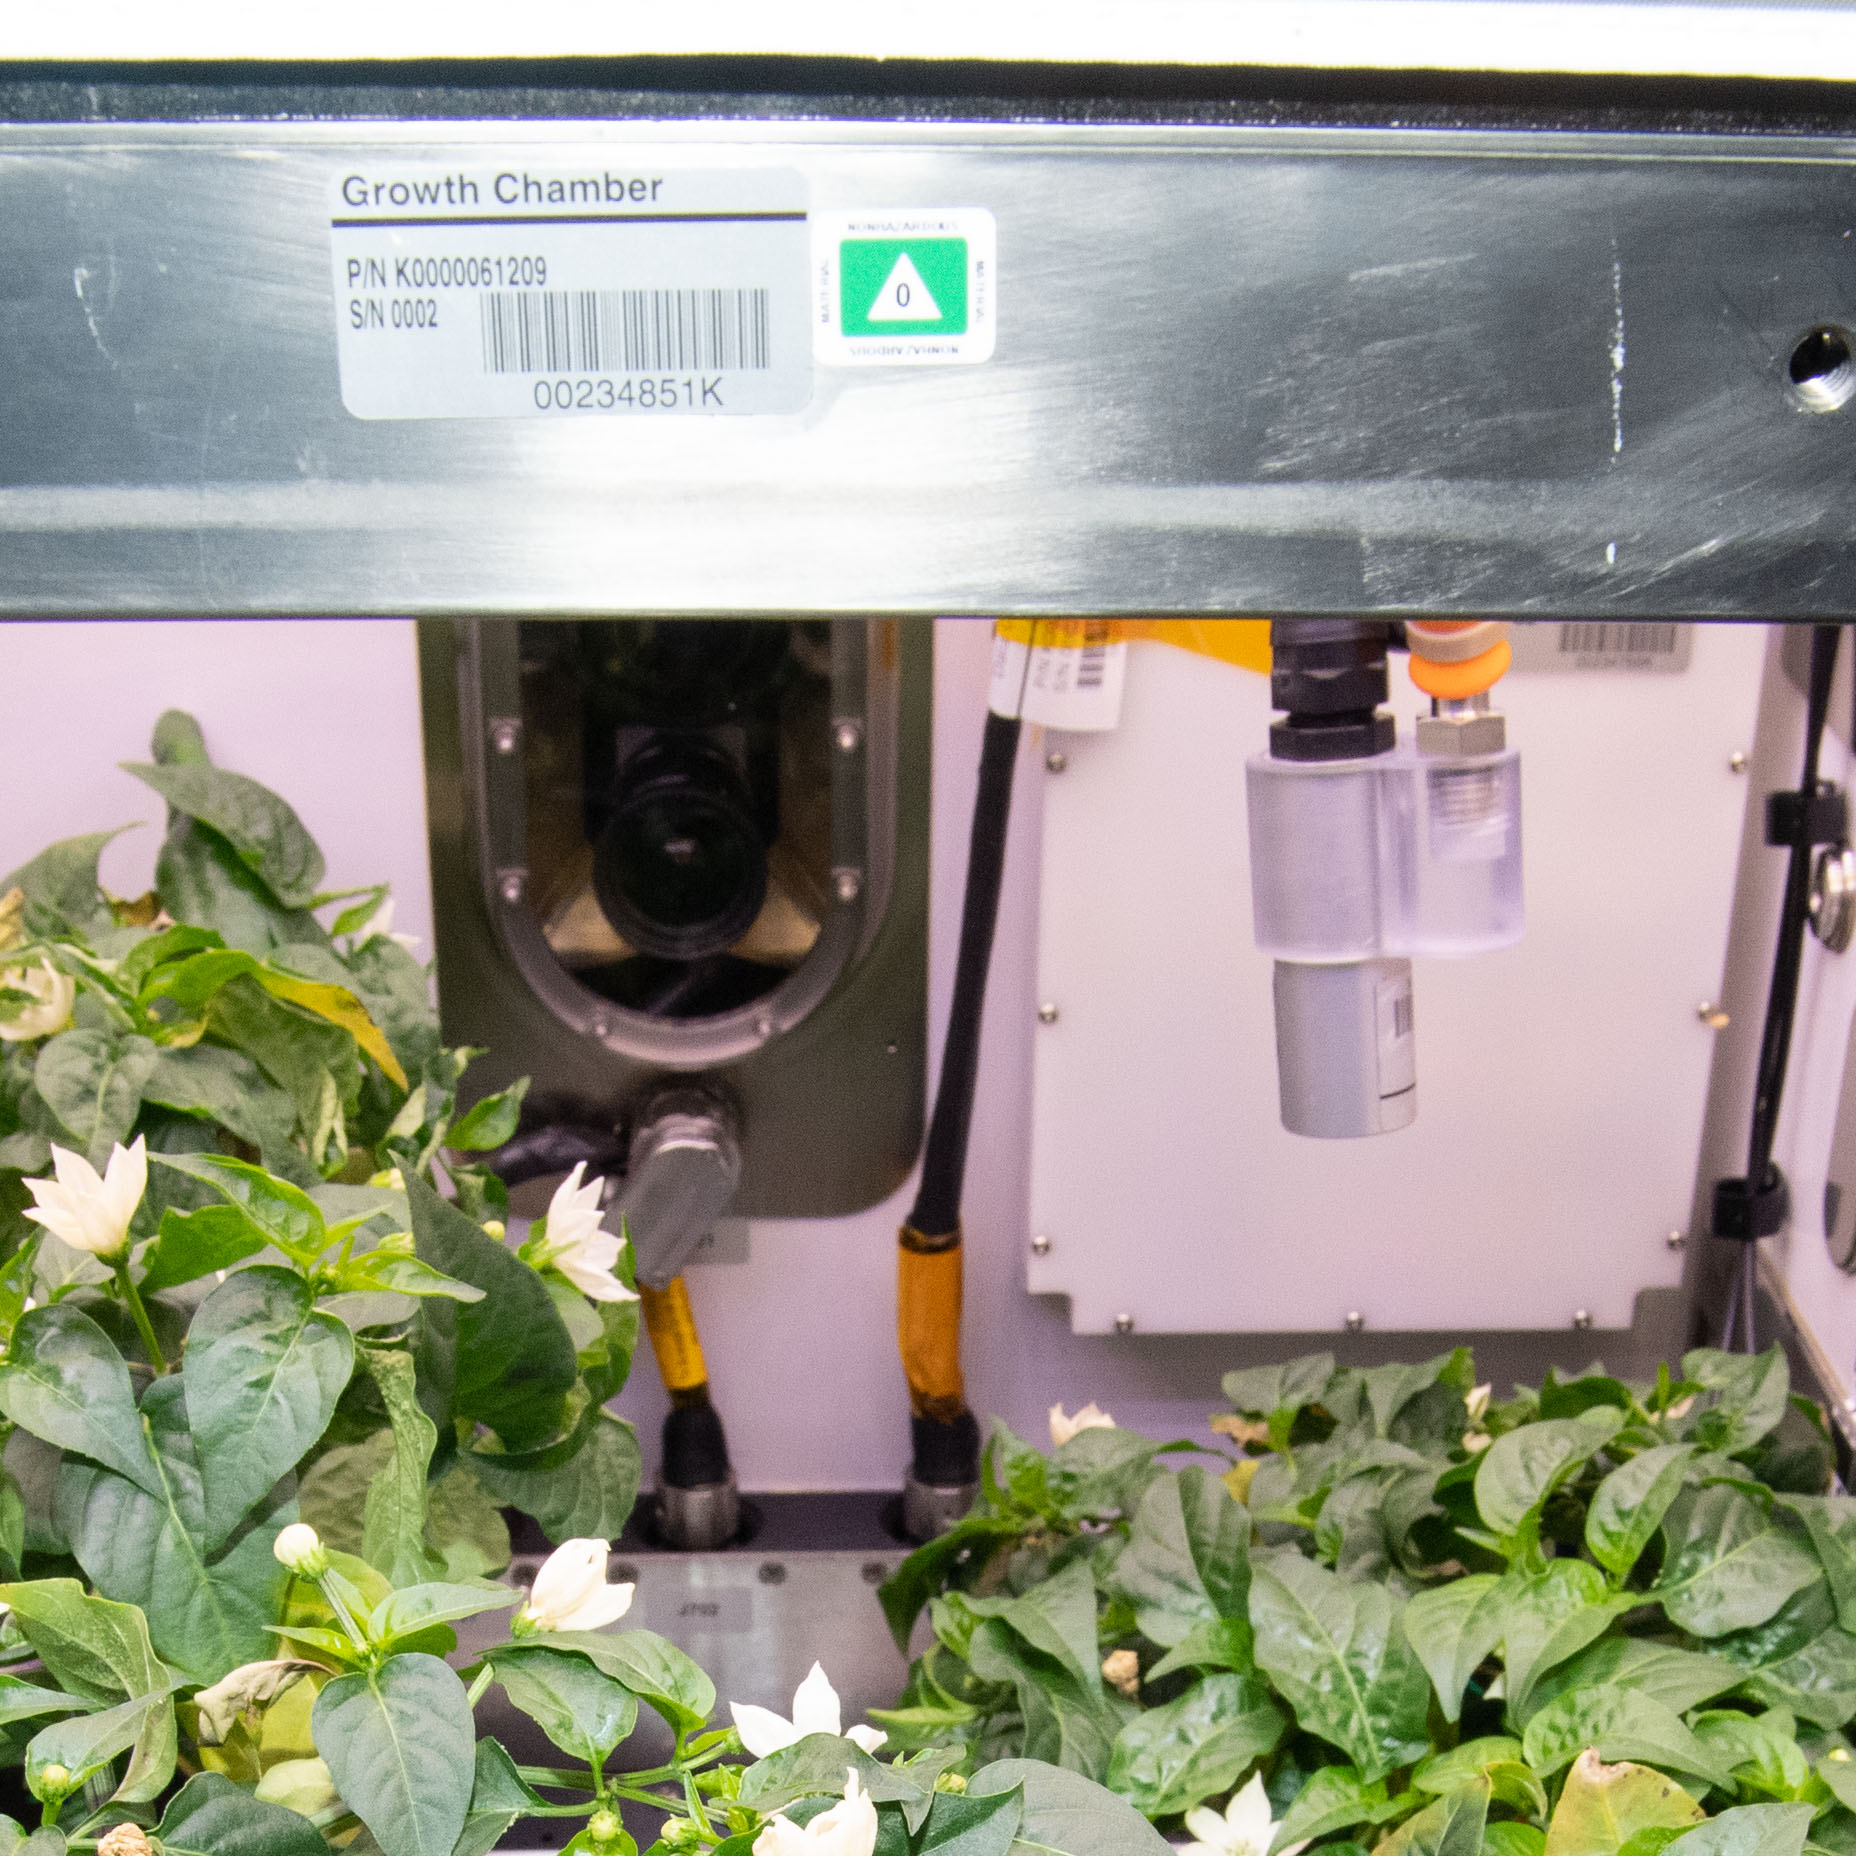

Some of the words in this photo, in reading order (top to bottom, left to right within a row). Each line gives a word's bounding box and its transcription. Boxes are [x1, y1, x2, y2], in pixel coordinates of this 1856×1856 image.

[342, 174, 479, 206] Growth
[493, 171, 663, 204] Chamber
[346, 257, 386, 288] P/N
[395, 256, 547, 287] K0000061209
[896, 283, 911, 307] 0
[349, 298, 385, 329] S/N
[392, 298, 438, 328] 0002
[533, 376, 724, 410] 00234851K
